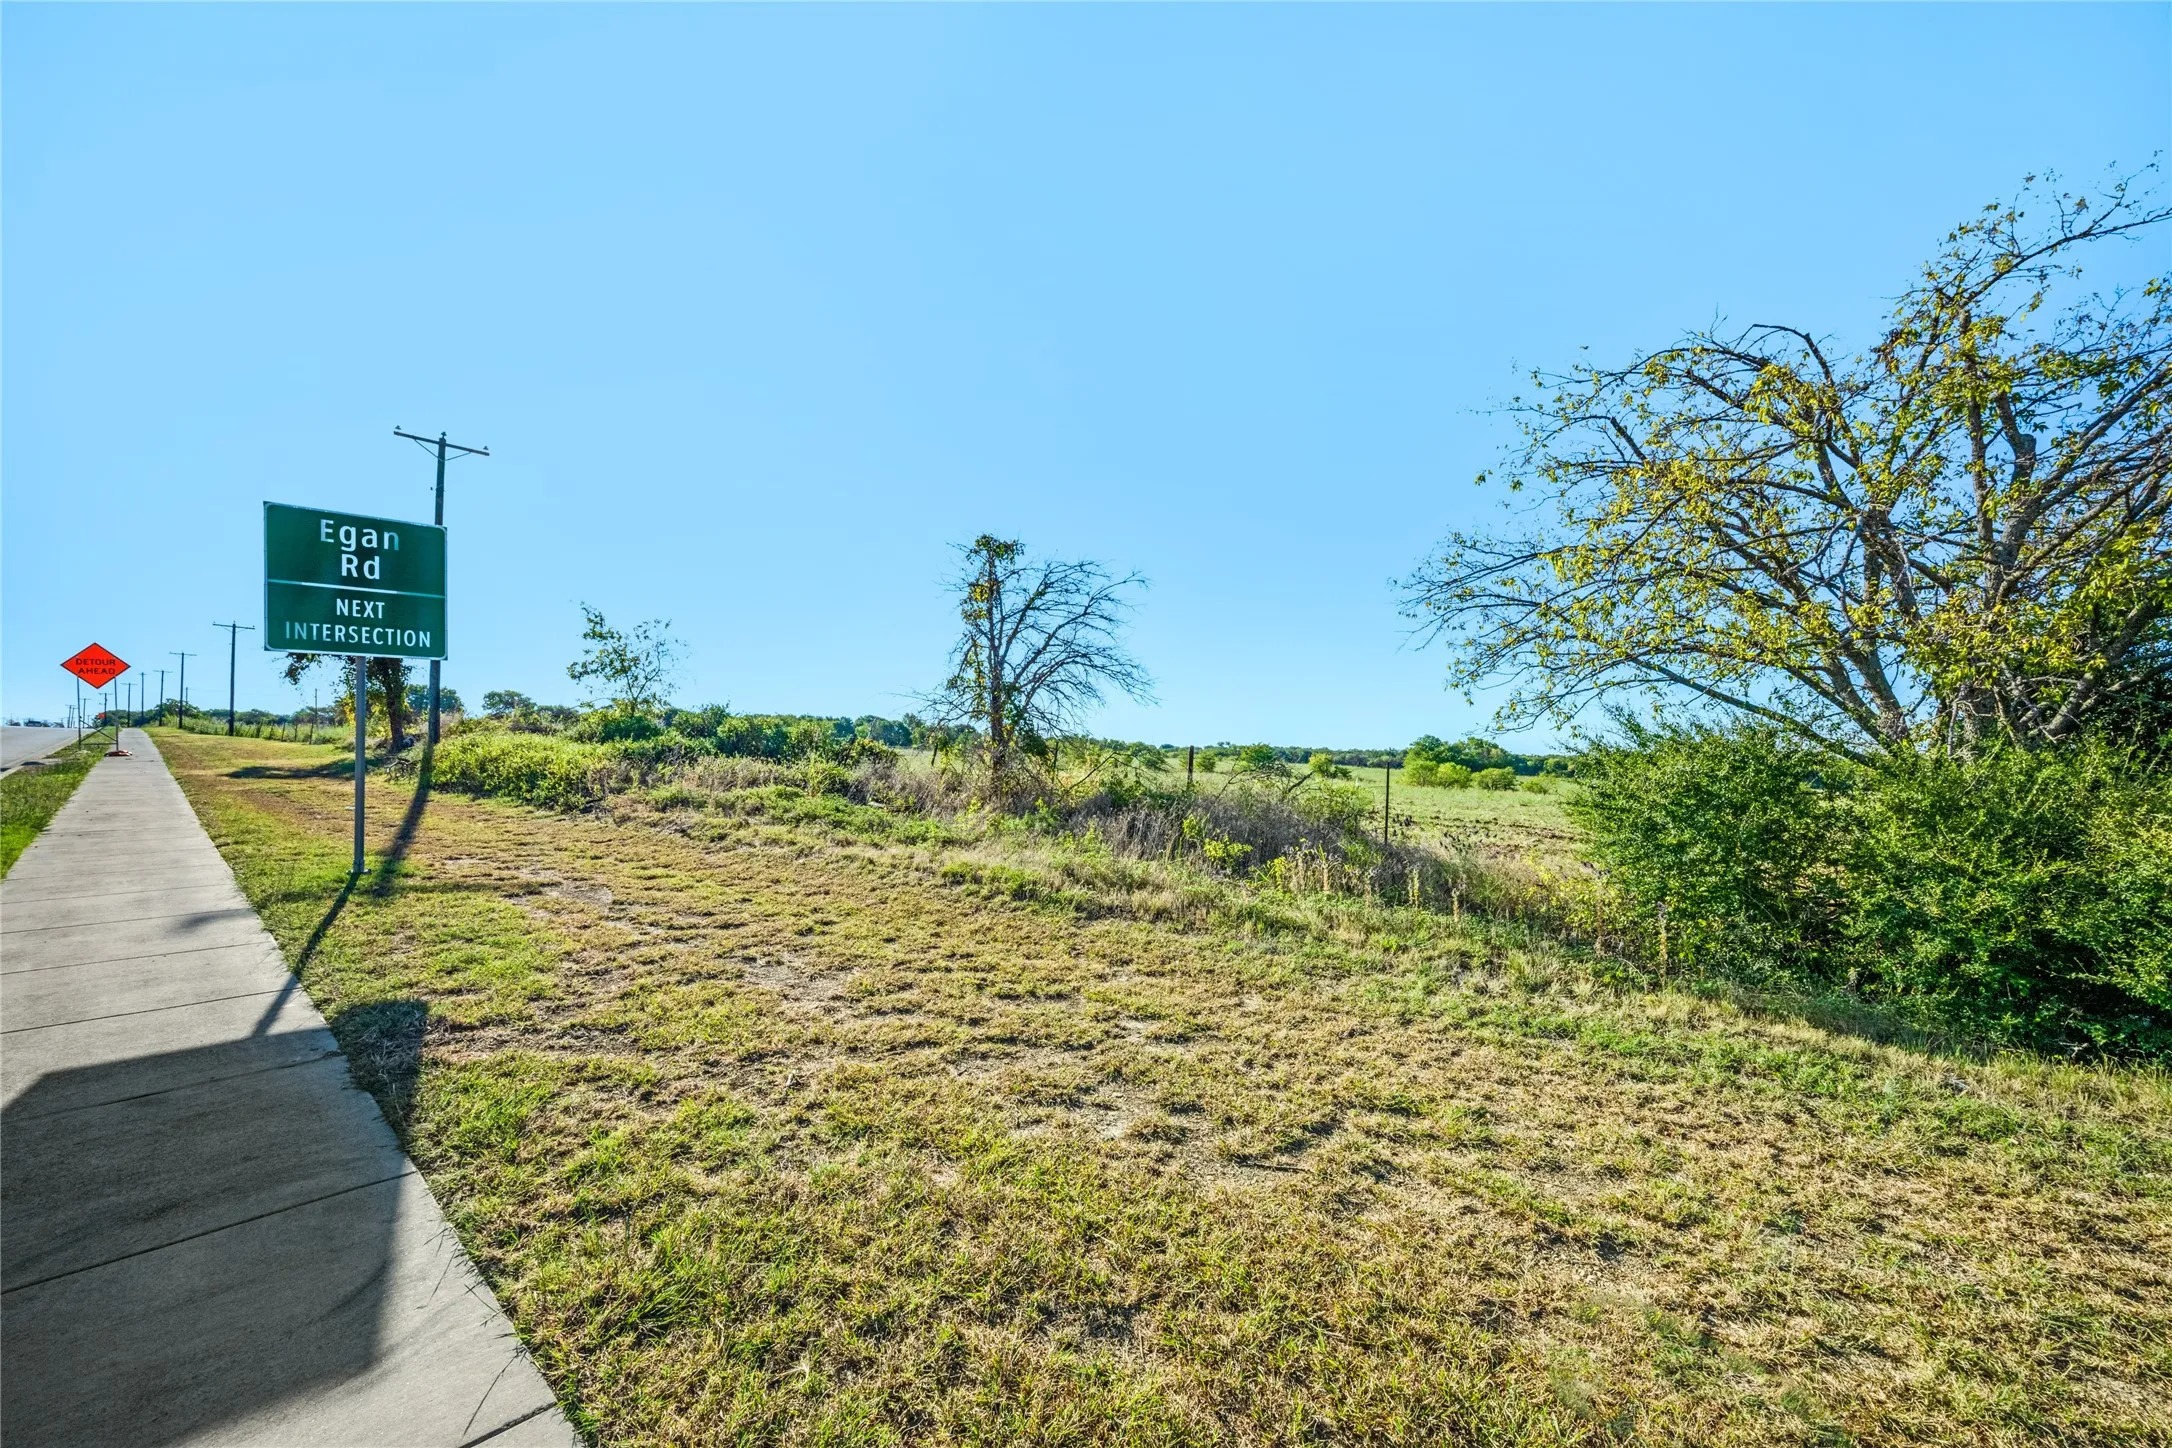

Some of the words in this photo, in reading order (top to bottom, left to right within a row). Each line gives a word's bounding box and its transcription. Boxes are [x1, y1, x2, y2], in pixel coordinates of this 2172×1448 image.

[320, 519, 399, 551] Egan
[341, 553, 380, 579] Rd
[336, 598, 385, 618] NEXT
[285, 621, 430, 648] INTERSECTION
[76, 658, 116, 666] DETOUR
